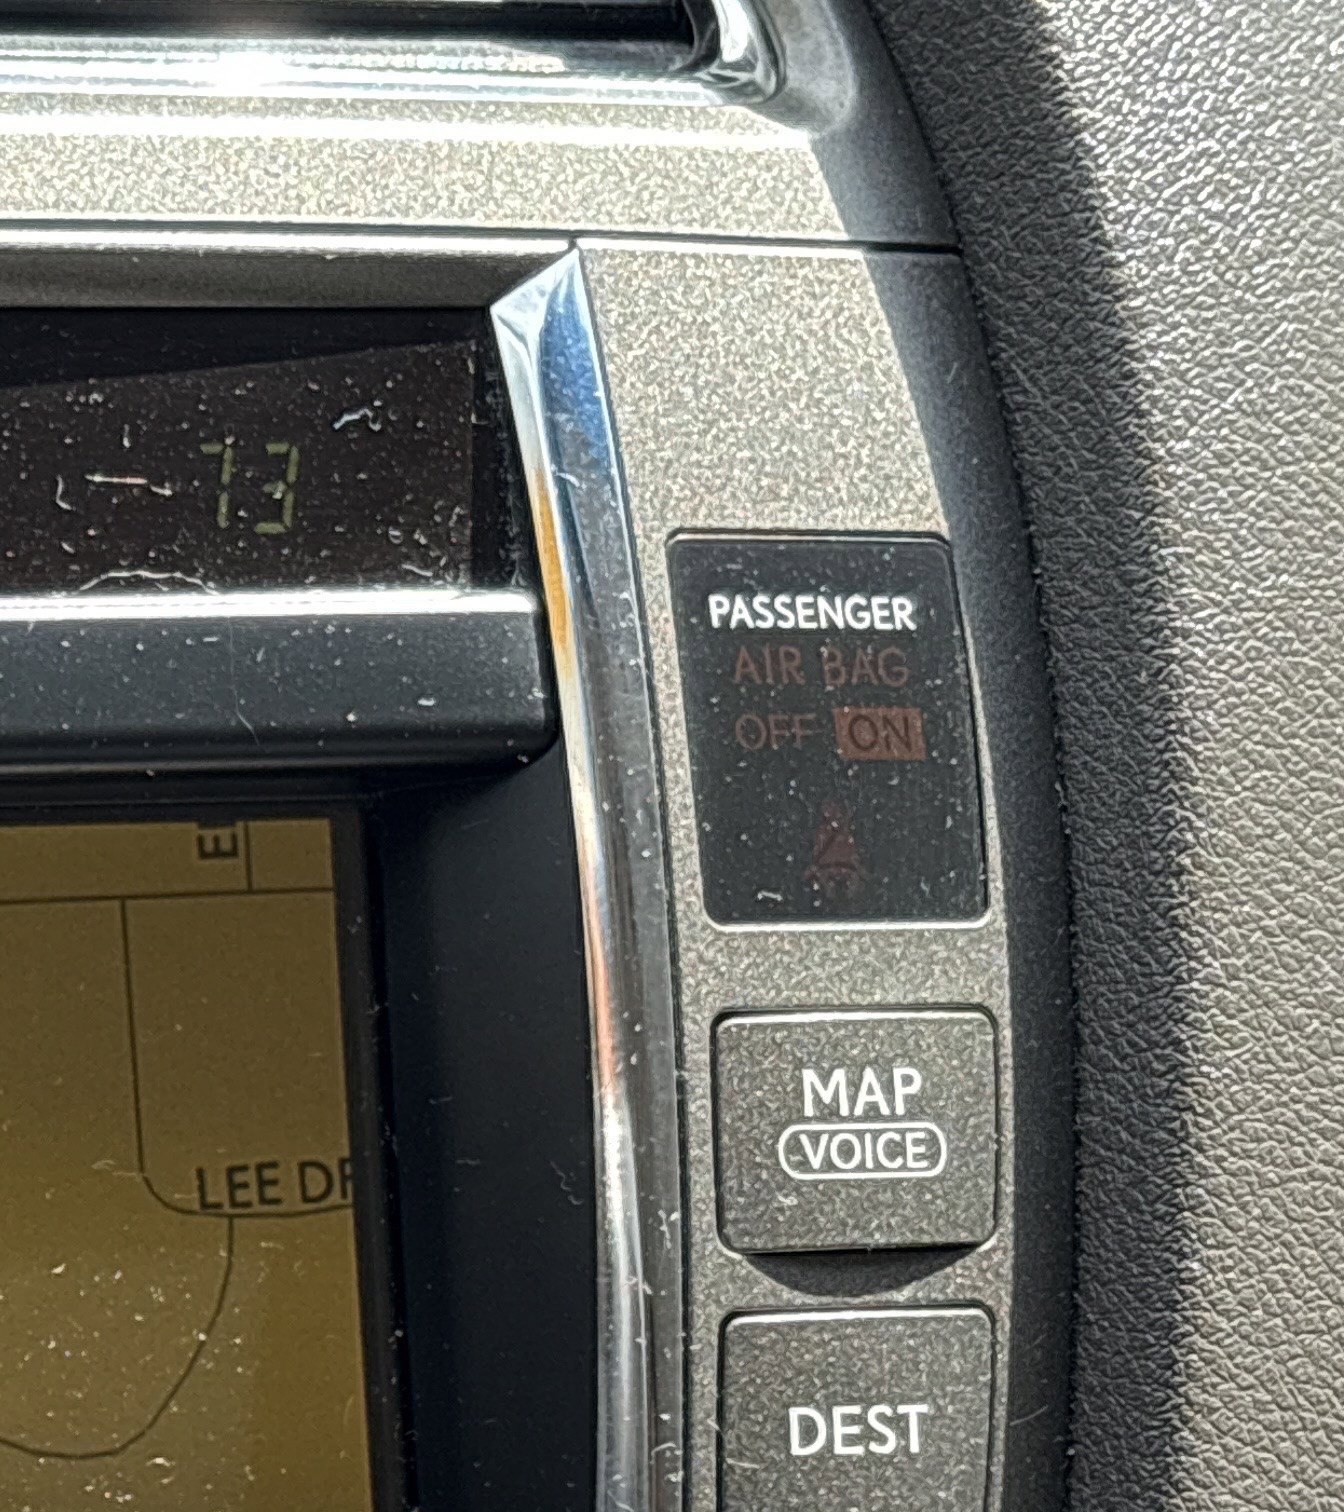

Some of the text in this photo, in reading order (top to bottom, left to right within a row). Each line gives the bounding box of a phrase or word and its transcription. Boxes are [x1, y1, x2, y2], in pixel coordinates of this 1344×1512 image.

[199, 442, 299, 533] 73
[708, 593, 916, 631] PASSENGER
[734, 644, 911, 687] AIR BAG
[734, 713, 914, 753] OFF ON
[802, 1067, 922, 1117] MAP
[800, 1131, 928, 1170] VOICE
[196, 1160, 281, 1210] LEE
[788, 1404, 929, 1457] DEST
